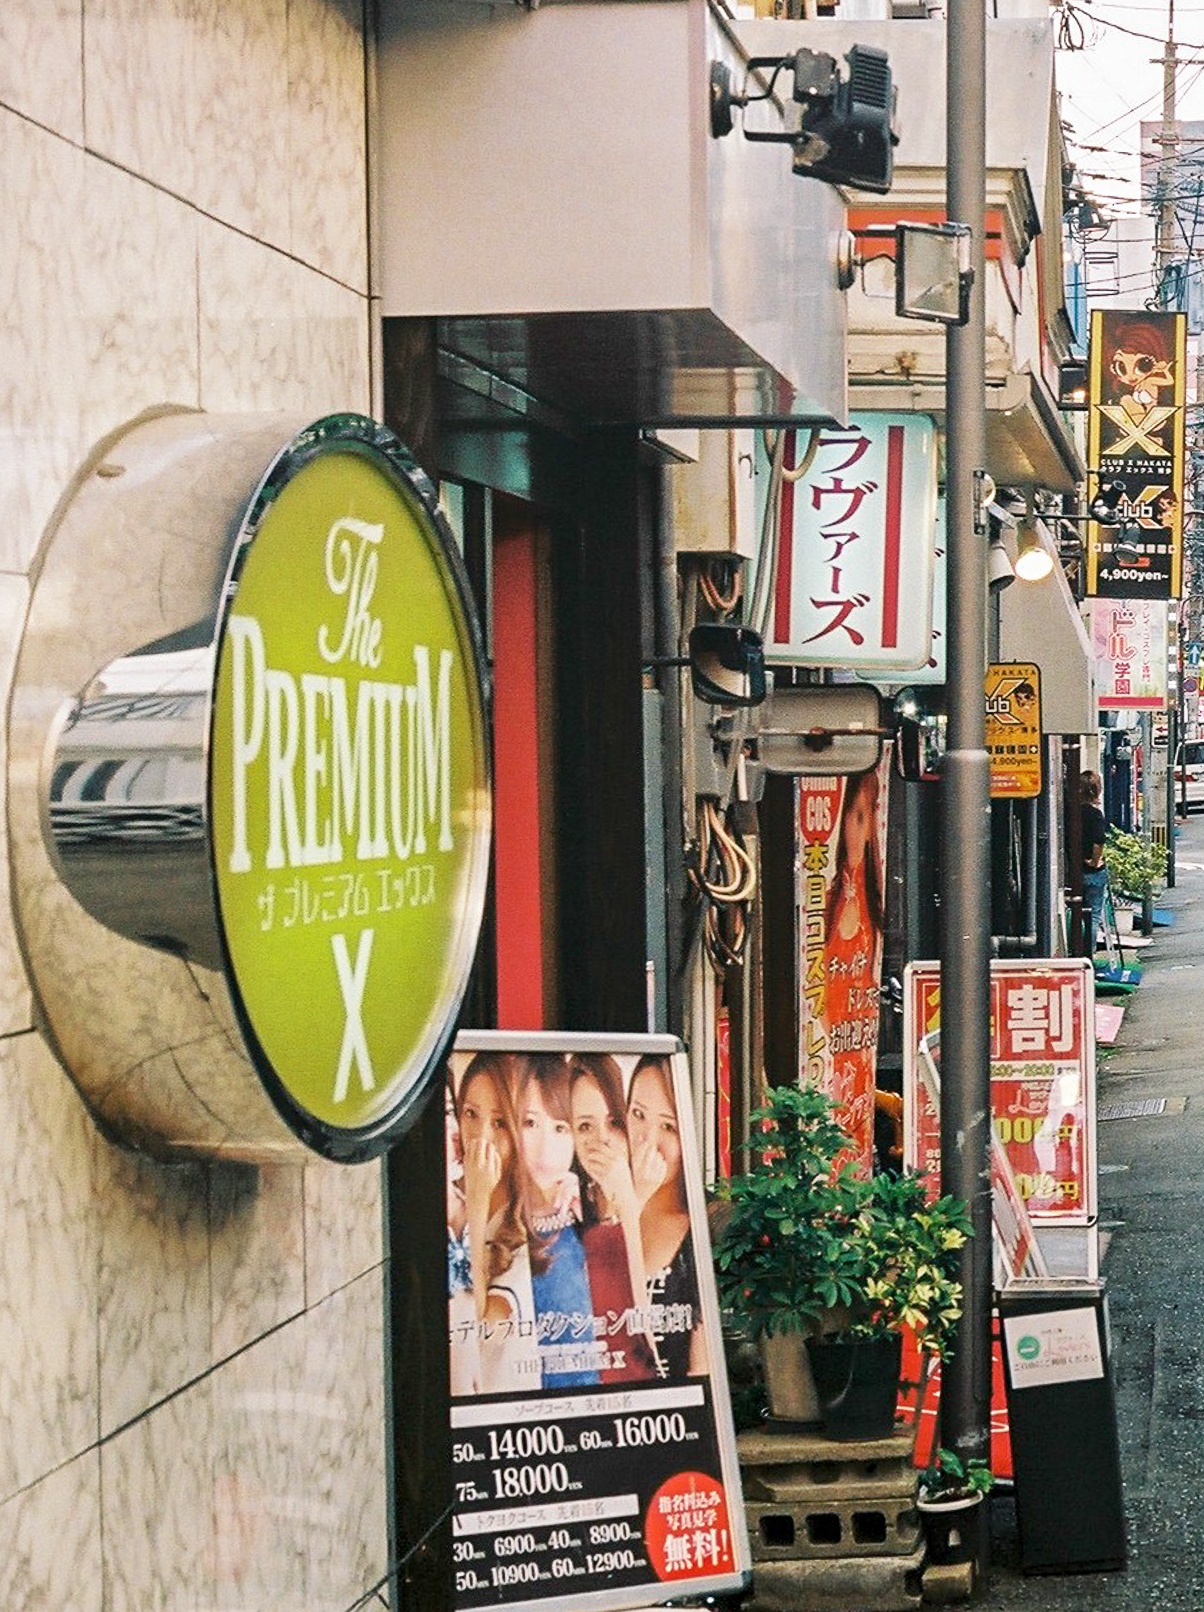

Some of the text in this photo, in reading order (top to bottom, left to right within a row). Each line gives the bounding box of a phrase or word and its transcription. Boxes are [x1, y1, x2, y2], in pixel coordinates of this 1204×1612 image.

[802, 424, 879, 646] ラヴァーズ
[317, 516, 385, 665] The
[1109, 603, 1137, 695] ドル学園
[228, 614, 455, 874] PREMIUM
[985, 696, 1010, 713] ub
[807, 796, 832, 831] COS
[282, 873, 370, 927] プレミアム
[330, 928, 375, 1102] X
[663, 1528, 729, 1573] 無料!
